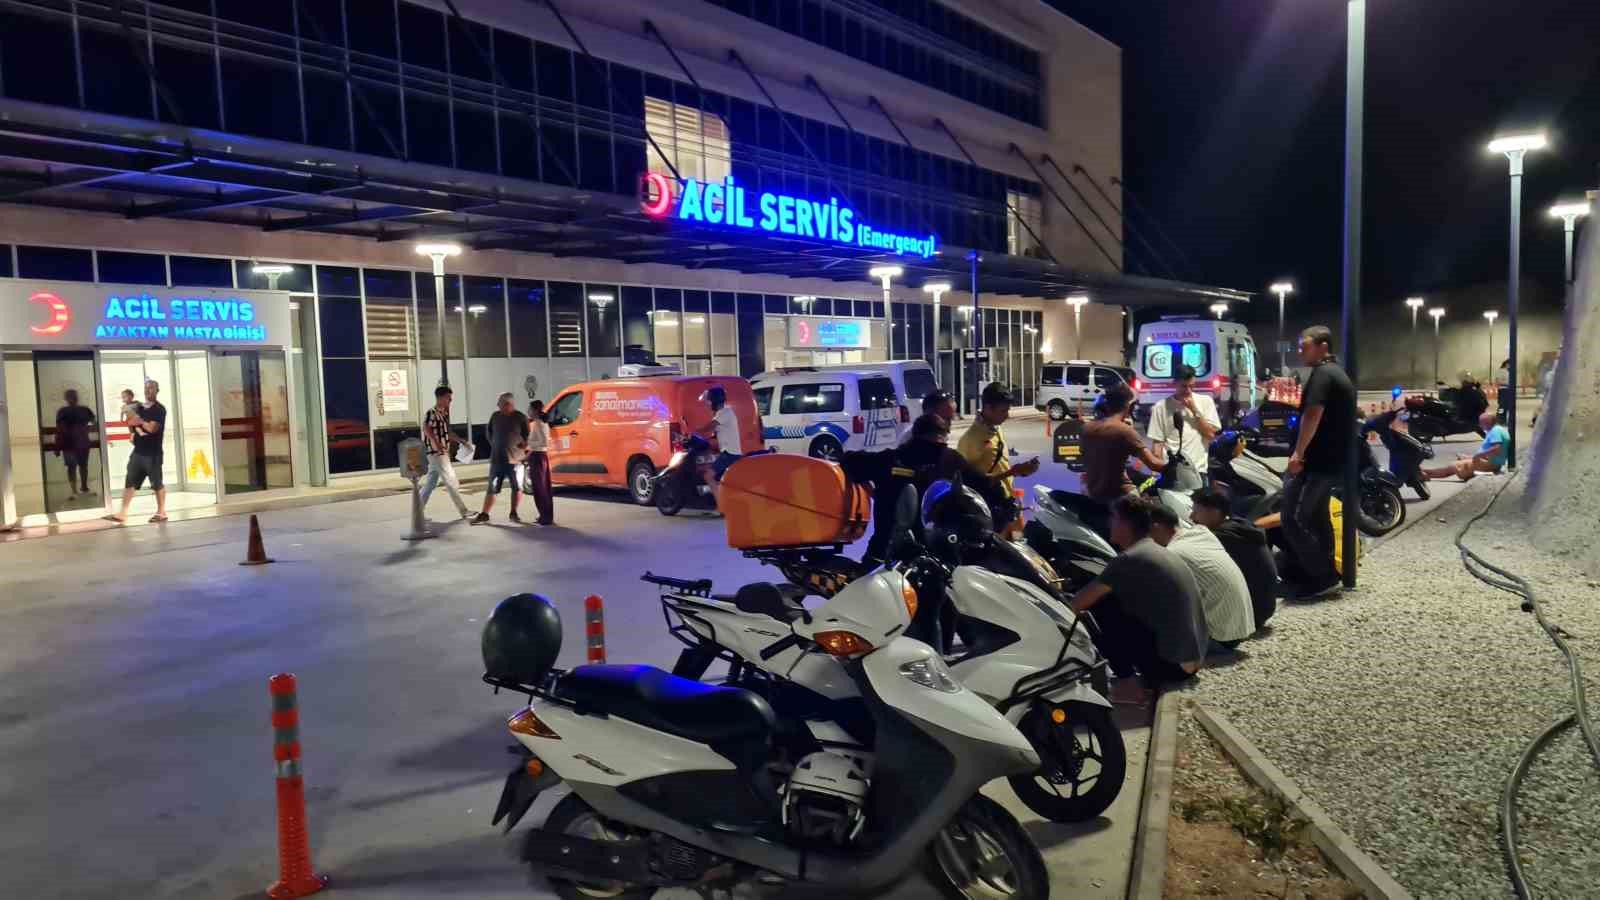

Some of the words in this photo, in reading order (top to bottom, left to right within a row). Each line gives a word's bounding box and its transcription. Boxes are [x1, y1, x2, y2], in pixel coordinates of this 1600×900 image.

[679, 176, 754, 227] ACİL
[760, 192, 854, 243] SERVİS
[857, 224, 936, 258] (Emergency)
[106, 294, 166, 320] ACİL
[170, 298, 254, 321] SERVİS
[96, 325, 169, 338] AYAKTAN
[174, 326, 223, 339] HASTA
